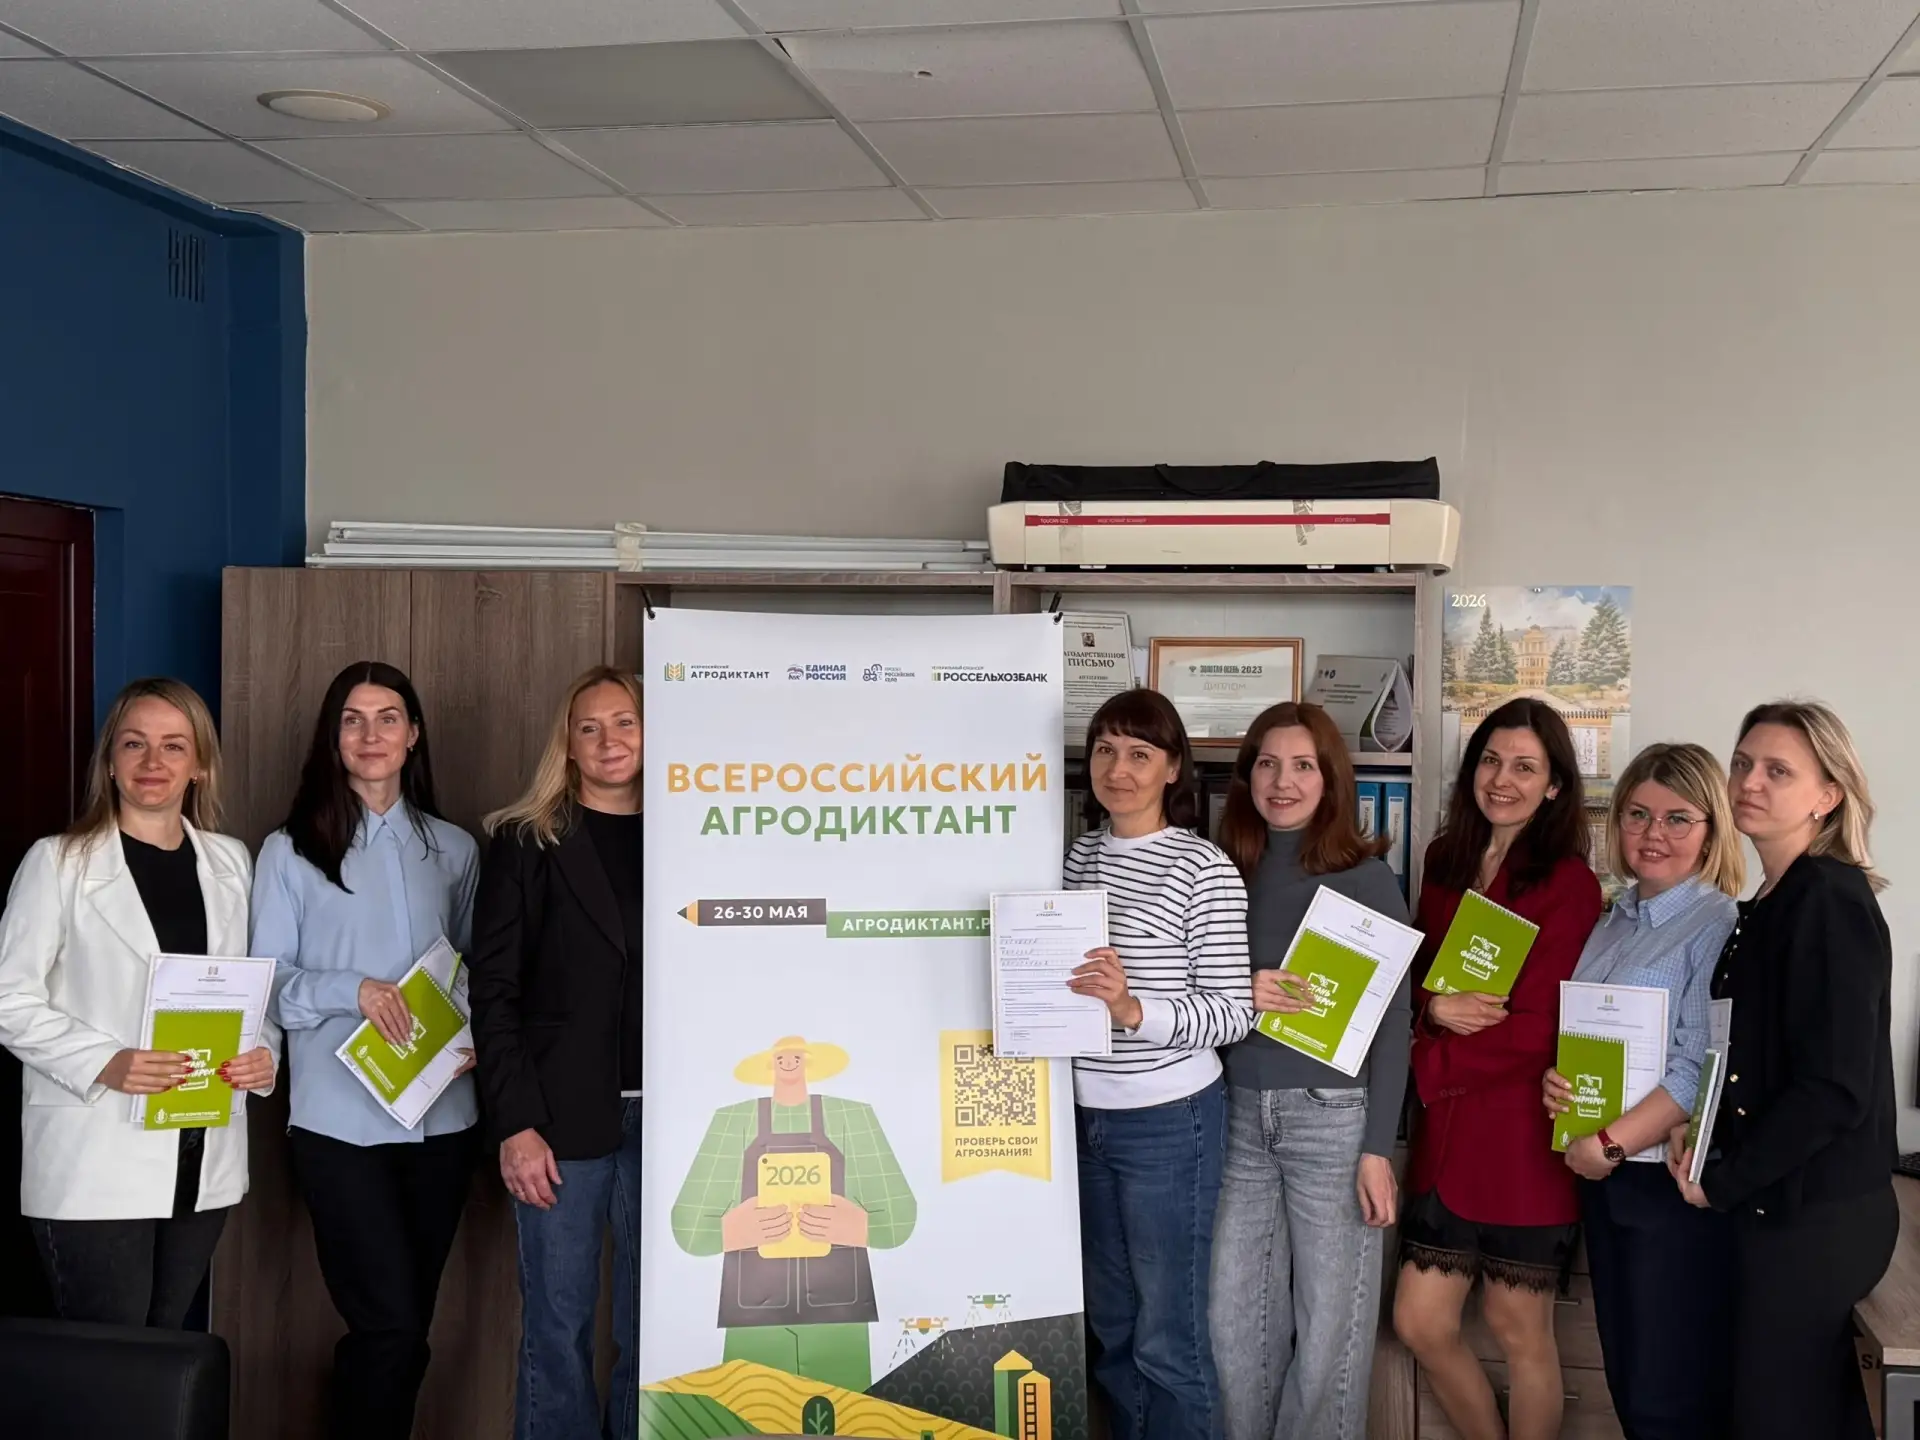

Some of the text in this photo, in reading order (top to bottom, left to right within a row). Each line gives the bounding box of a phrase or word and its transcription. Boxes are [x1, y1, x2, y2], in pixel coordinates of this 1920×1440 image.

[1451, 593, 1487, 608] 2026
[1063, 651, 1126, 659] АГОДАРСТВЕННОЕ
[806, 664, 847, 673] ЕДИНАЯ
[1067, 659, 1115, 668] ПИСЬМО
[1241, 665, 1263, 674] 2023
[690, 671, 770, 680] АГРОДИКТАНТ
[806, 673, 847, 681] РОССИЯ
[943, 672, 1048, 683] РОССЕЛЬХОЗБАНК
[1203, 681, 1246, 691] ДИПЛОМ
[667, 752, 1048, 793] ВСЕРОССИЙСКИЙ
[700, 805, 1017, 842] АГРОДИКТАНТ
[713, 905, 808, 920] 26-30 МАЯ
[842, 917, 991, 933] АГРОДИКТАНТ.Р
[1470, 946, 1493, 961] СТАНЬ
[190, 1060, 207, 1069] АНЬ
[1574, 1095, 1607, 1106] ЕРМЕРОМ
[955, 1136, 1038, 1146] ПРОВЕРЬ СВОИ
[955, 1148, 1033, 1158] АГРОЗНАНИЯ!
[766, 1164, 821, 1186] 2026
